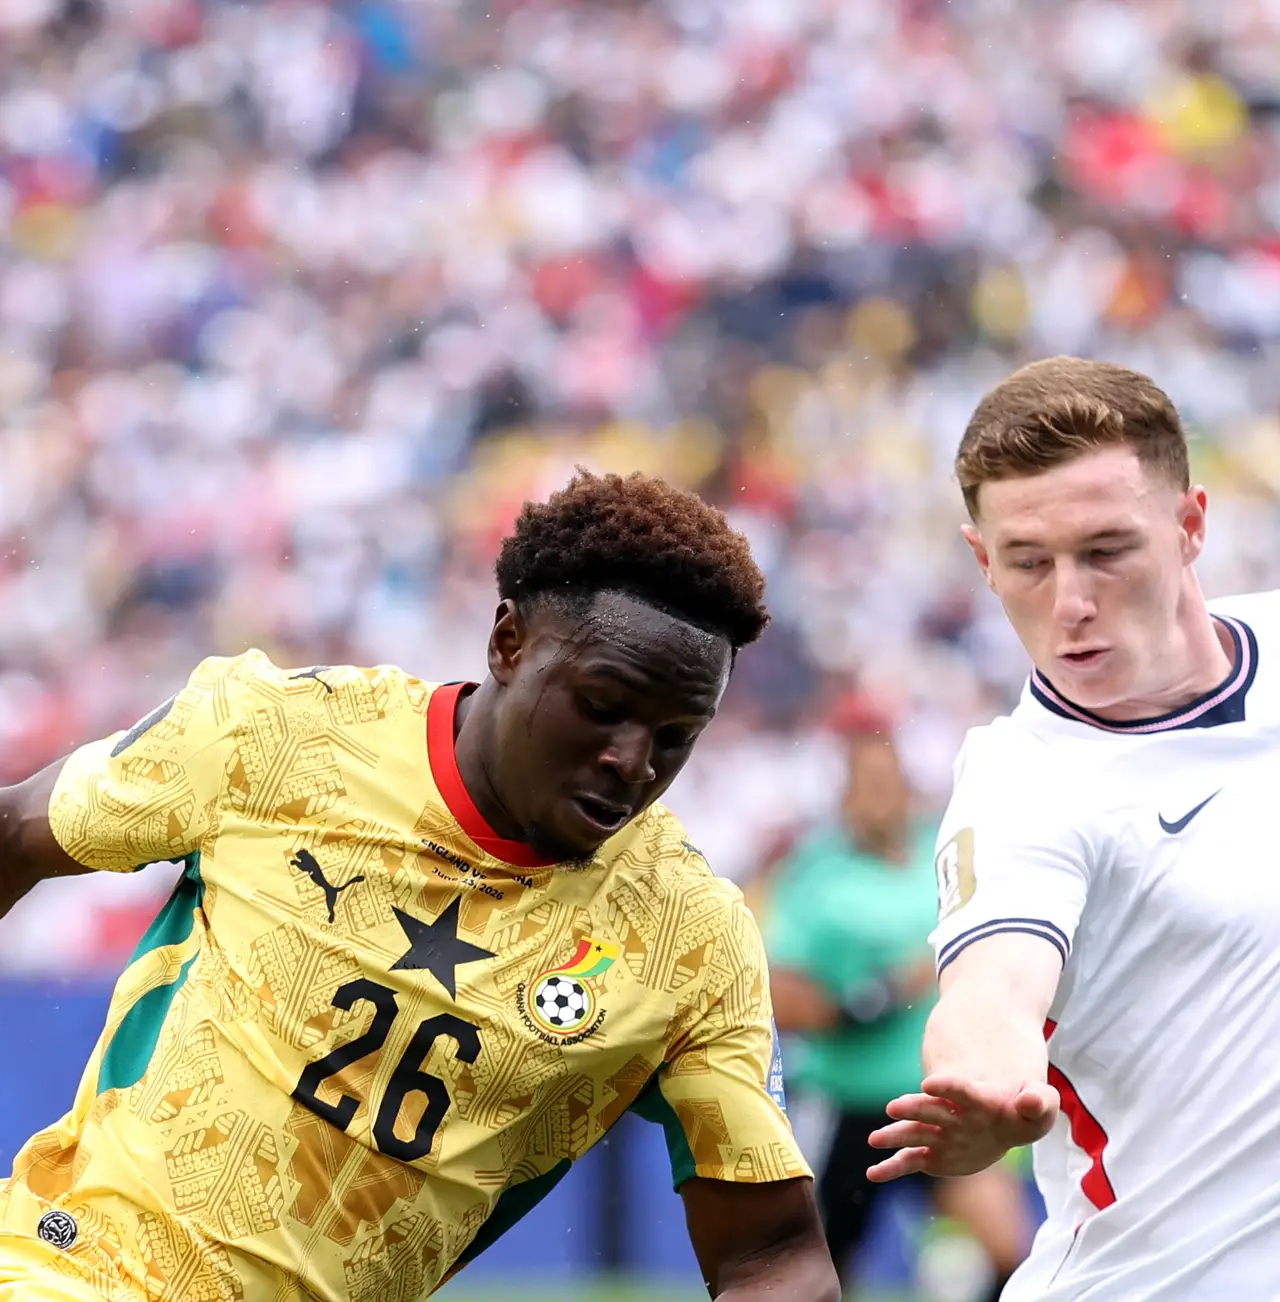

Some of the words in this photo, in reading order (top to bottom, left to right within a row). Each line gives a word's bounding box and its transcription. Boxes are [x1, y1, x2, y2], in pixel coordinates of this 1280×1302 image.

[479, 883, 505, 900] 2026
[516, 983, 526, 1015] GHANA
[521, 1014, 560, 1046] FOOTBALL
[560, 1008, 608, 1046] ASSOCIATION
[291, 978, 482, 1163] 26
